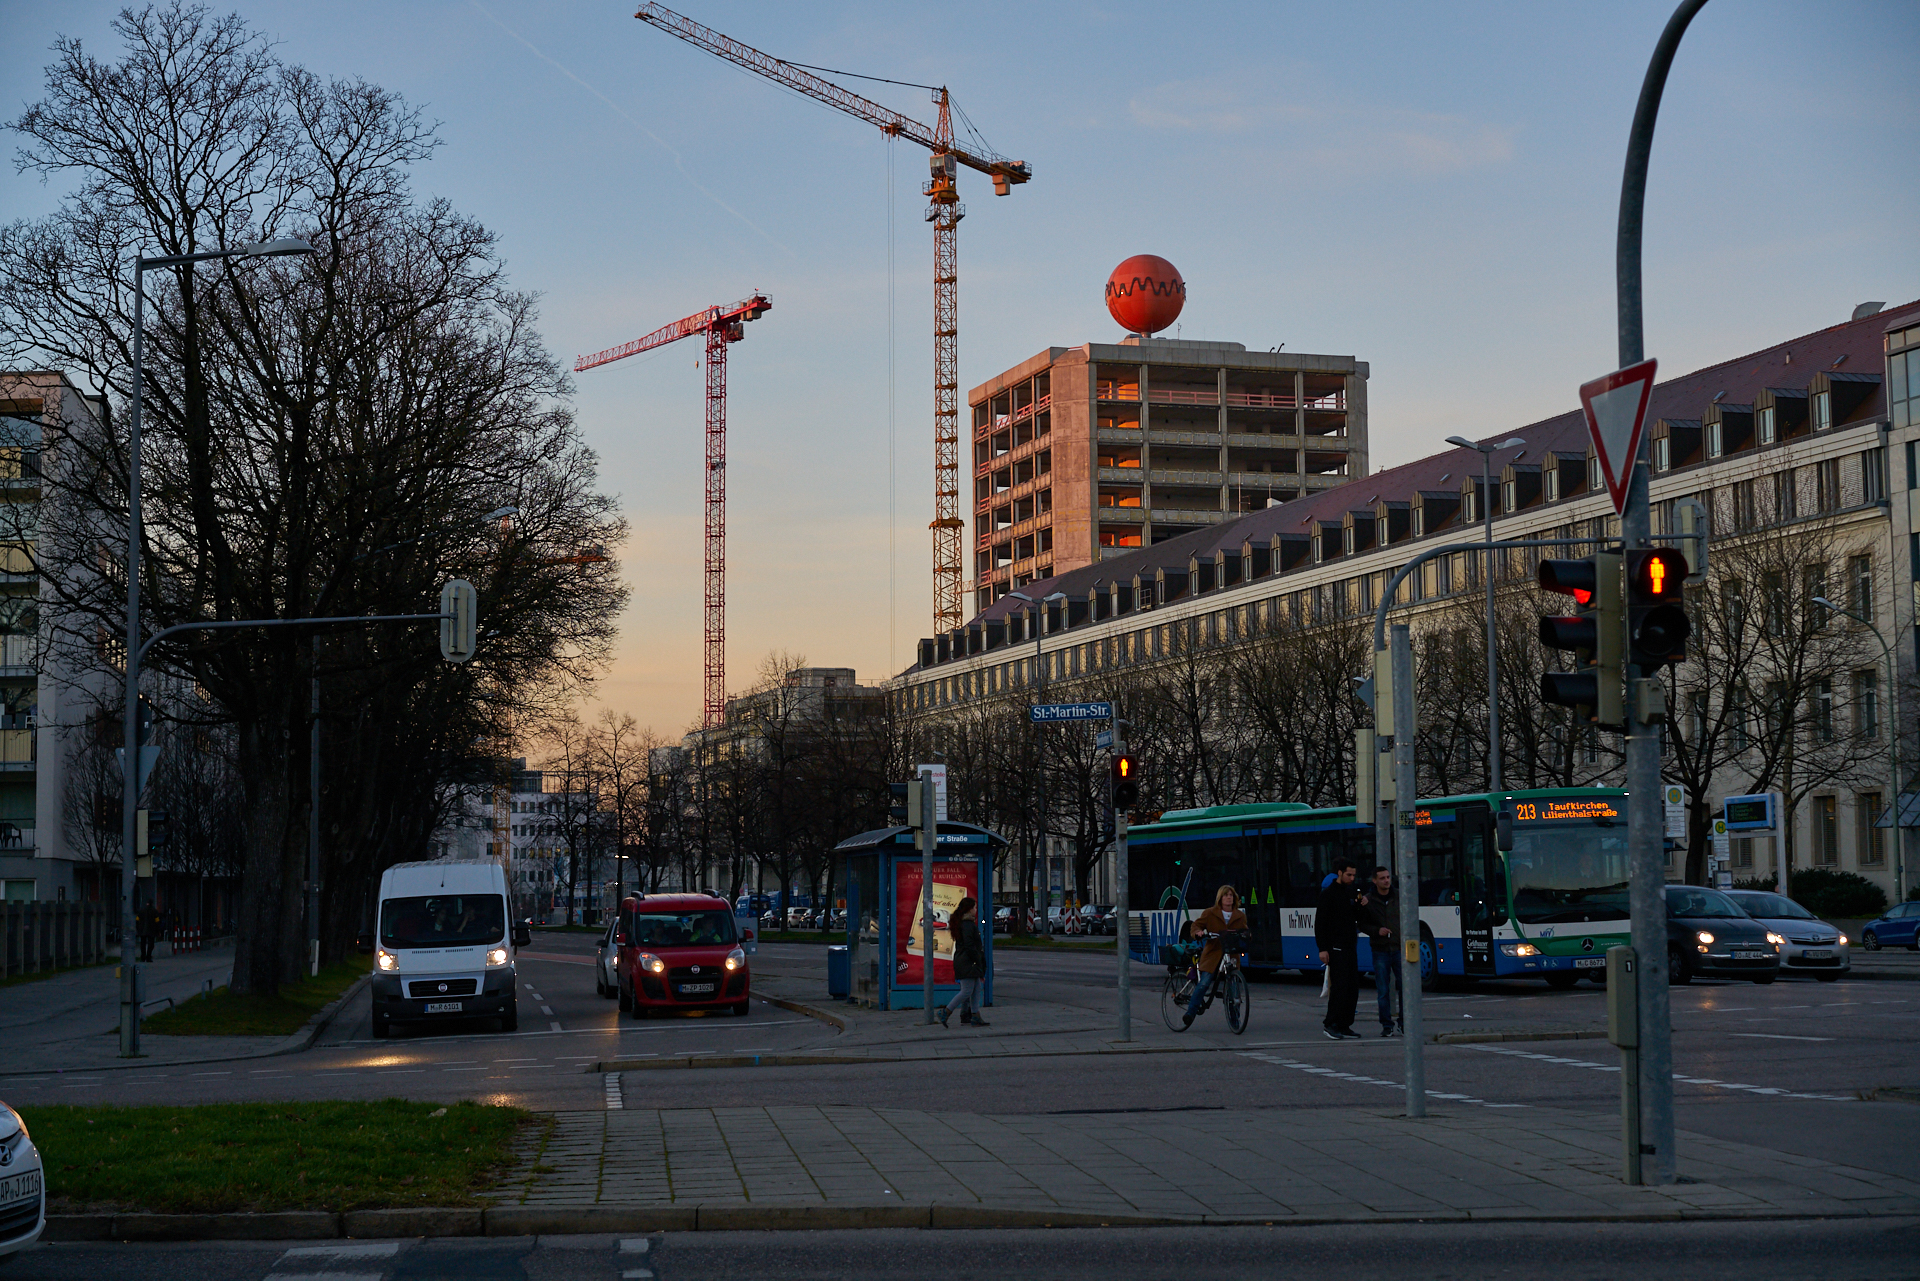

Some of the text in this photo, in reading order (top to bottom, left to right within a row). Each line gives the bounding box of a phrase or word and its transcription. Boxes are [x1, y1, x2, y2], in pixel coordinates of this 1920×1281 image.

[1033, 704, 1109, 719] St.-Martin-Str.
[1516, 803, 1536, 820] 213
[1548, 801, 1609, 811] Taufkirchen
[1541, 808, 1618, 819] Lilienthalstraße
[1626, 961, 1631, 971] 1
